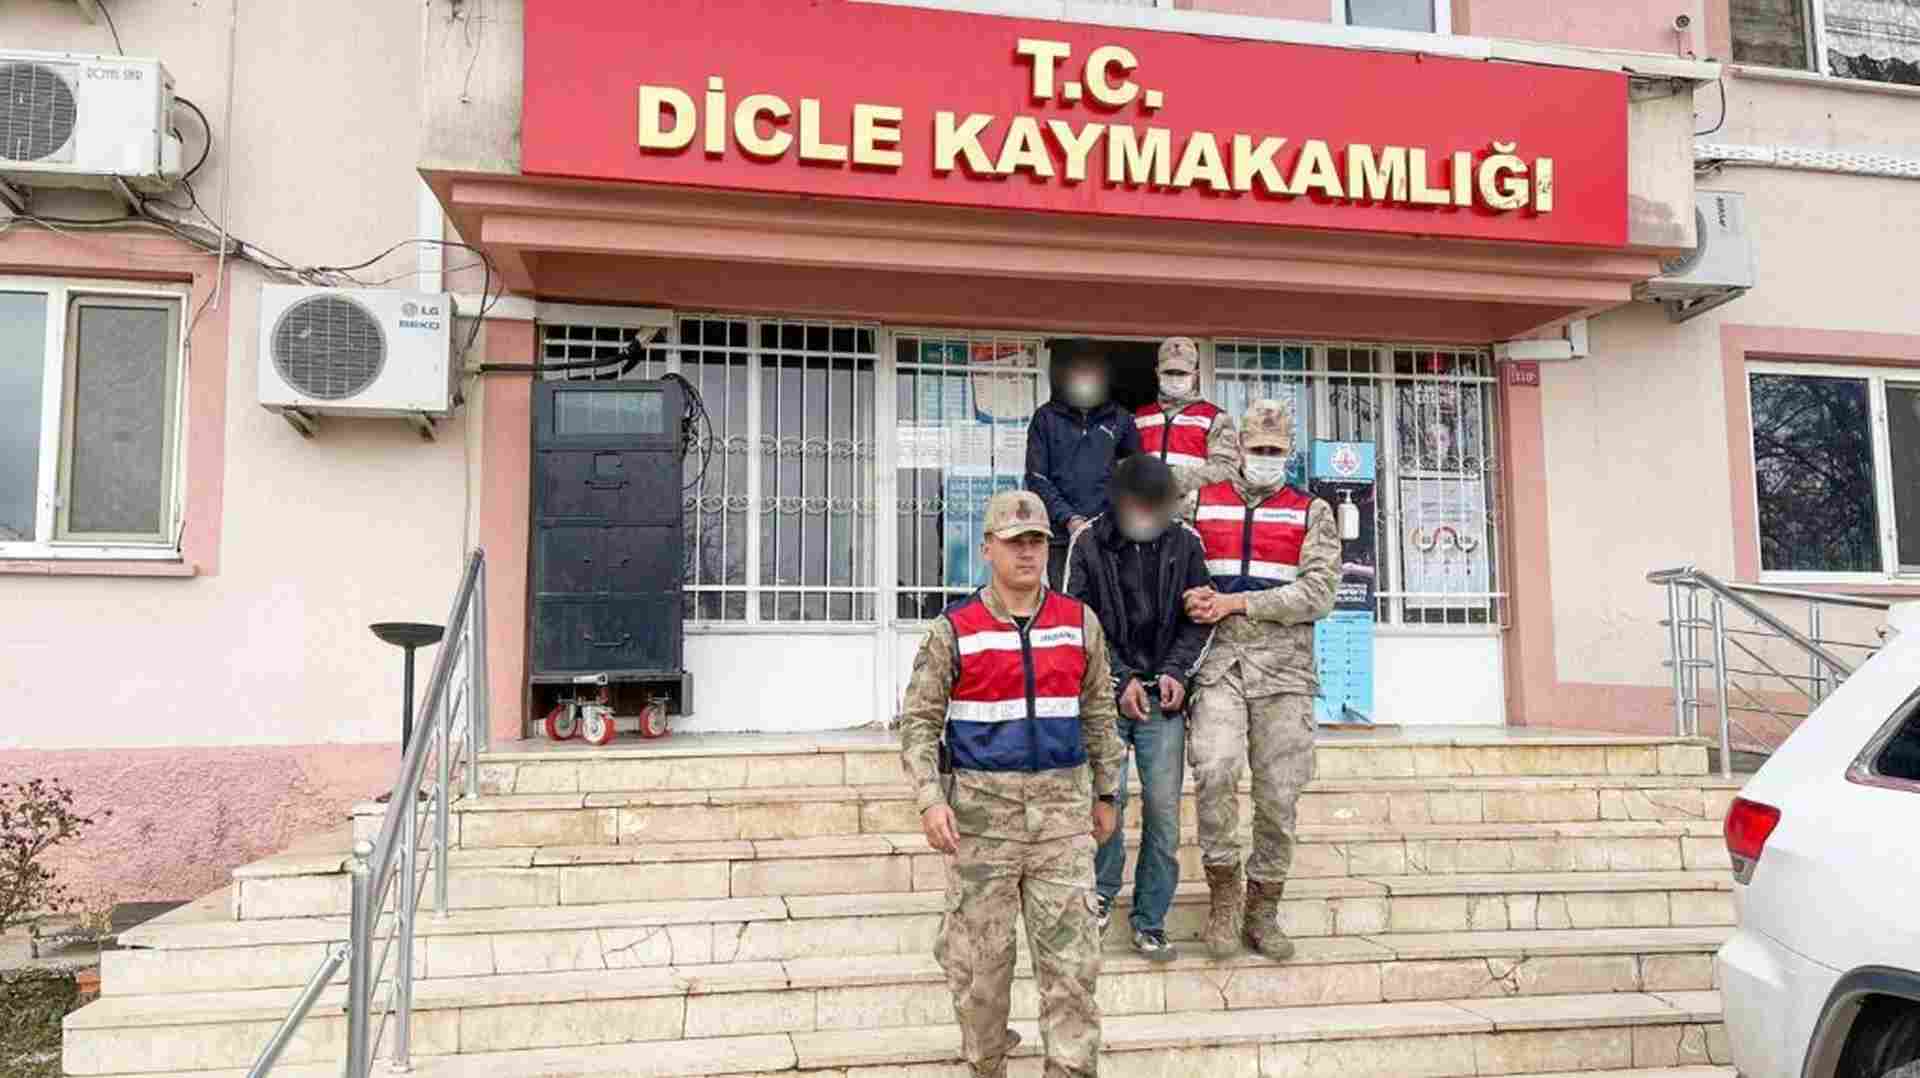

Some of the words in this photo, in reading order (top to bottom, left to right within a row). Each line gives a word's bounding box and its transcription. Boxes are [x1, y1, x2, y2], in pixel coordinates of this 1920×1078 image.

[1014, 37, 1165, 110] T.C.
[637, 75, 904, 169] DİCLE
[934, 110, 1554, 212] KAYMAKAMLIĞI
